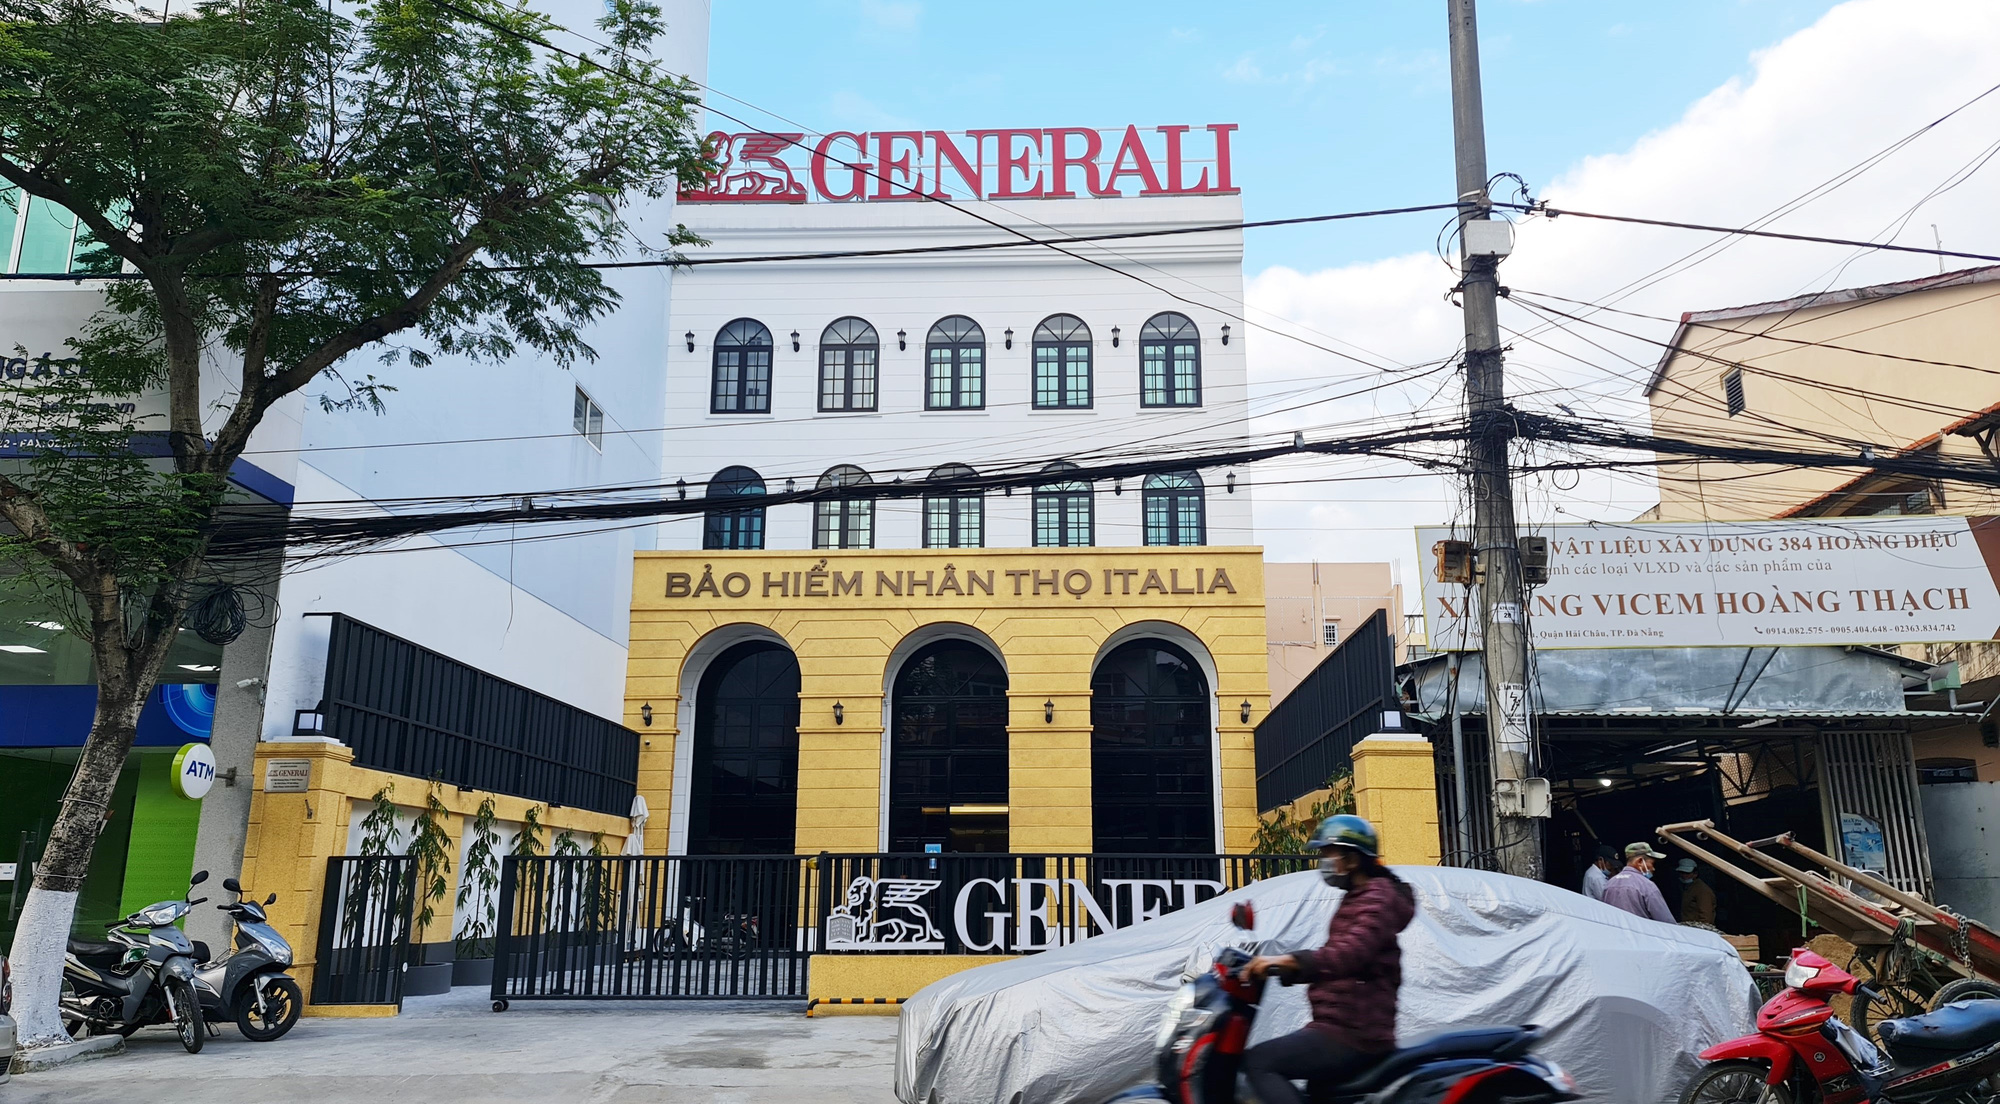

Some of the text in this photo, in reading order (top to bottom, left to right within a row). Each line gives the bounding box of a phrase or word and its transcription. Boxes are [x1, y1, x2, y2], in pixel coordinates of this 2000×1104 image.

[811, 124, 1241, 202] GENERALI
[0, 357, 27, 379] G
[1550, 530, 1958, 558] VẬT LIỆU XÂY DỰNG 384 HOÀNG DIỆU
[1574, 562, 1597, 575] các
[1602, 563, 1628, 576] loại
[1633, 562, 1680, 574] VLXD
[1685, 562, 1702, 573] và
[1706, 561, 1729, 573] các
[1735, 560, 1758, 572] sản
[1764, 557, 1802, 574] phẩm
[1807, 558, 1832, 571] của
[664, 558, 1237, 600] BẢO HIỂM NHÂN THỌ ITALIA
[1591, 592, 1706, 615] VICEM
[1717, 585, 1840, 614] HOÀNG
[1849, 587, 1971, 616] THẠCH
[1540, 630, 1563, 639] Quận
[1610, 629, 1625, 637] TP.
[1627, 629, 1639, 637] Đà
[1765, 626, 1823, 635] 0914.082.575
[1830, 625, 1888, 634] 0905.404.648
[1894, 624, 1956, 633] 02363.834.742
[186, 760, 214, 781] ATM
